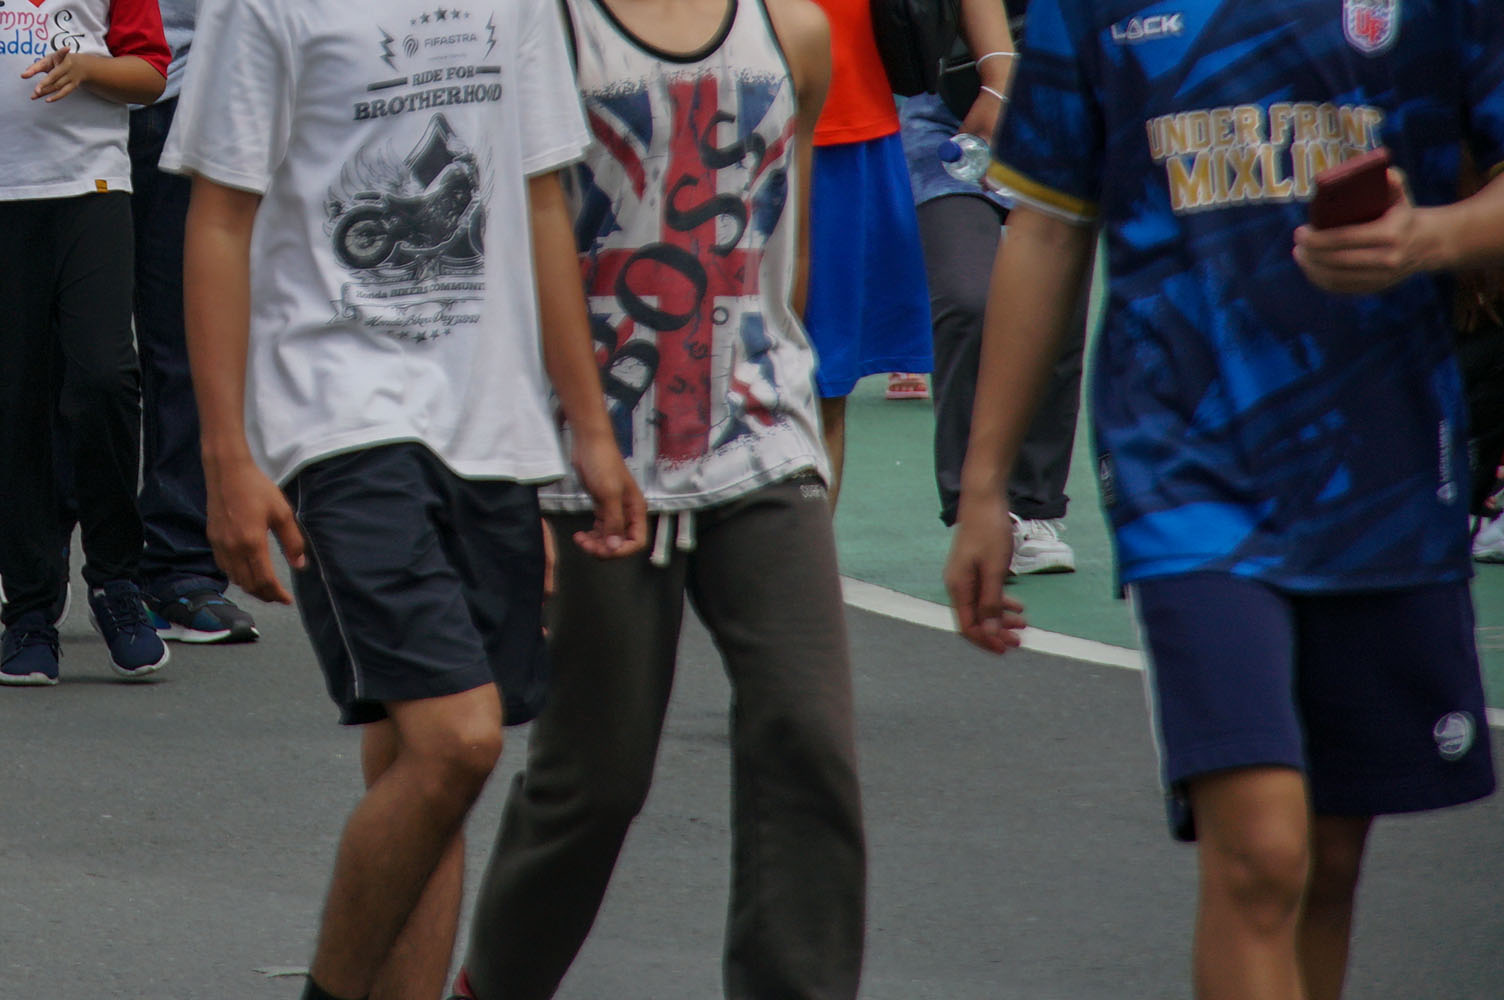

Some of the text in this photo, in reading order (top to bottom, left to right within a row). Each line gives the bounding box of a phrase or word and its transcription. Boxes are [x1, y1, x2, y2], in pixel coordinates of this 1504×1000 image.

[50, 9, 85, 54] &
[1110, 12, 1183, 42] LACK
[412, 65, 475, 86] RIDE FOR
[352, 83, 503, 121] BROTHERHOOD
[1145, 101, 1385, 161] UNDER FRONT
